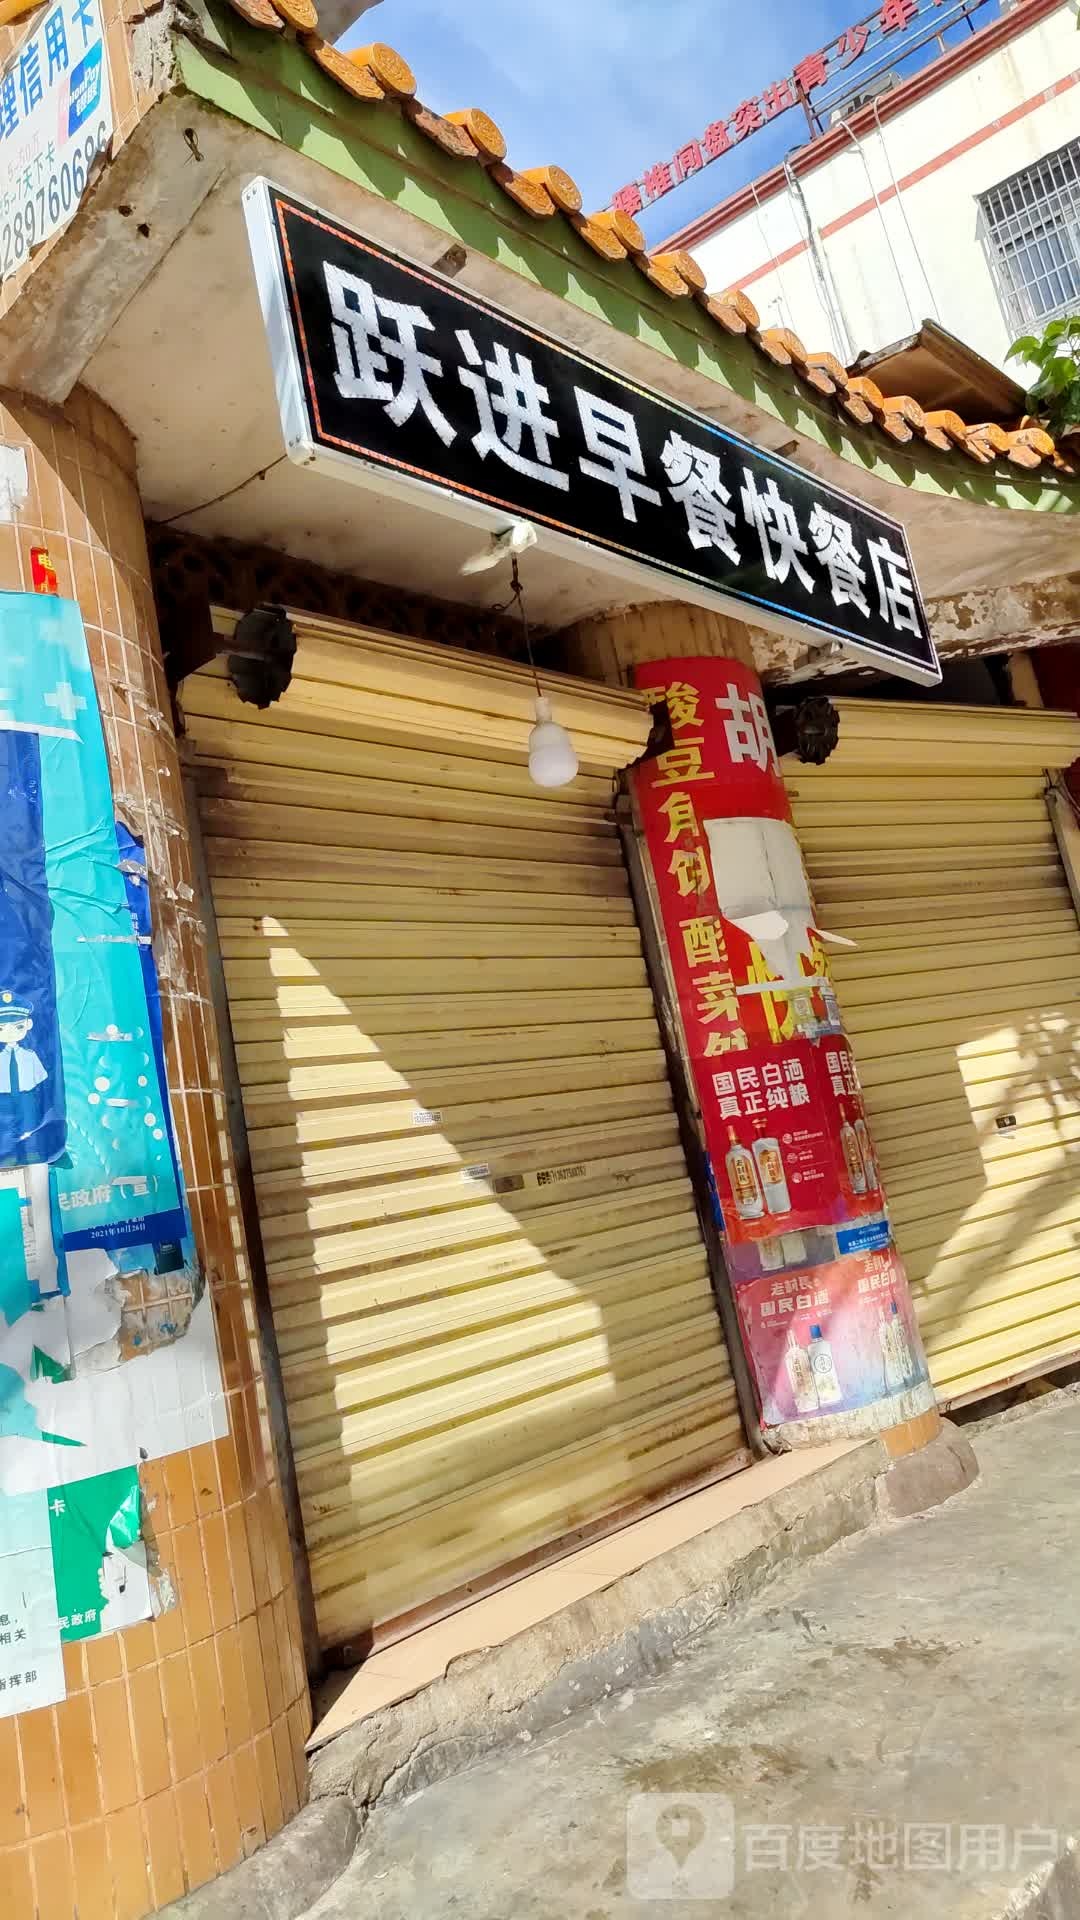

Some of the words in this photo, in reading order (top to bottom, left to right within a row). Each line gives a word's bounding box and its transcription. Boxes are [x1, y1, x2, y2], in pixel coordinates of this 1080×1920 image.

[611, 0, 943, 218] 腰椎间盘突出青少年
[321, 259, 924, 640] 跃进早餐快餐店
[711, 1058, 805, 1097] 国民白酒
[717, 1082, 810, 1120] 真正纯粮
[760, 1288, 829, 1317] 国民白酒
[49, 1498, 66, 1518] 卡
[59, 1608, 97, 1629] 民政府
[0, 1627, 27, 1646] 相关
